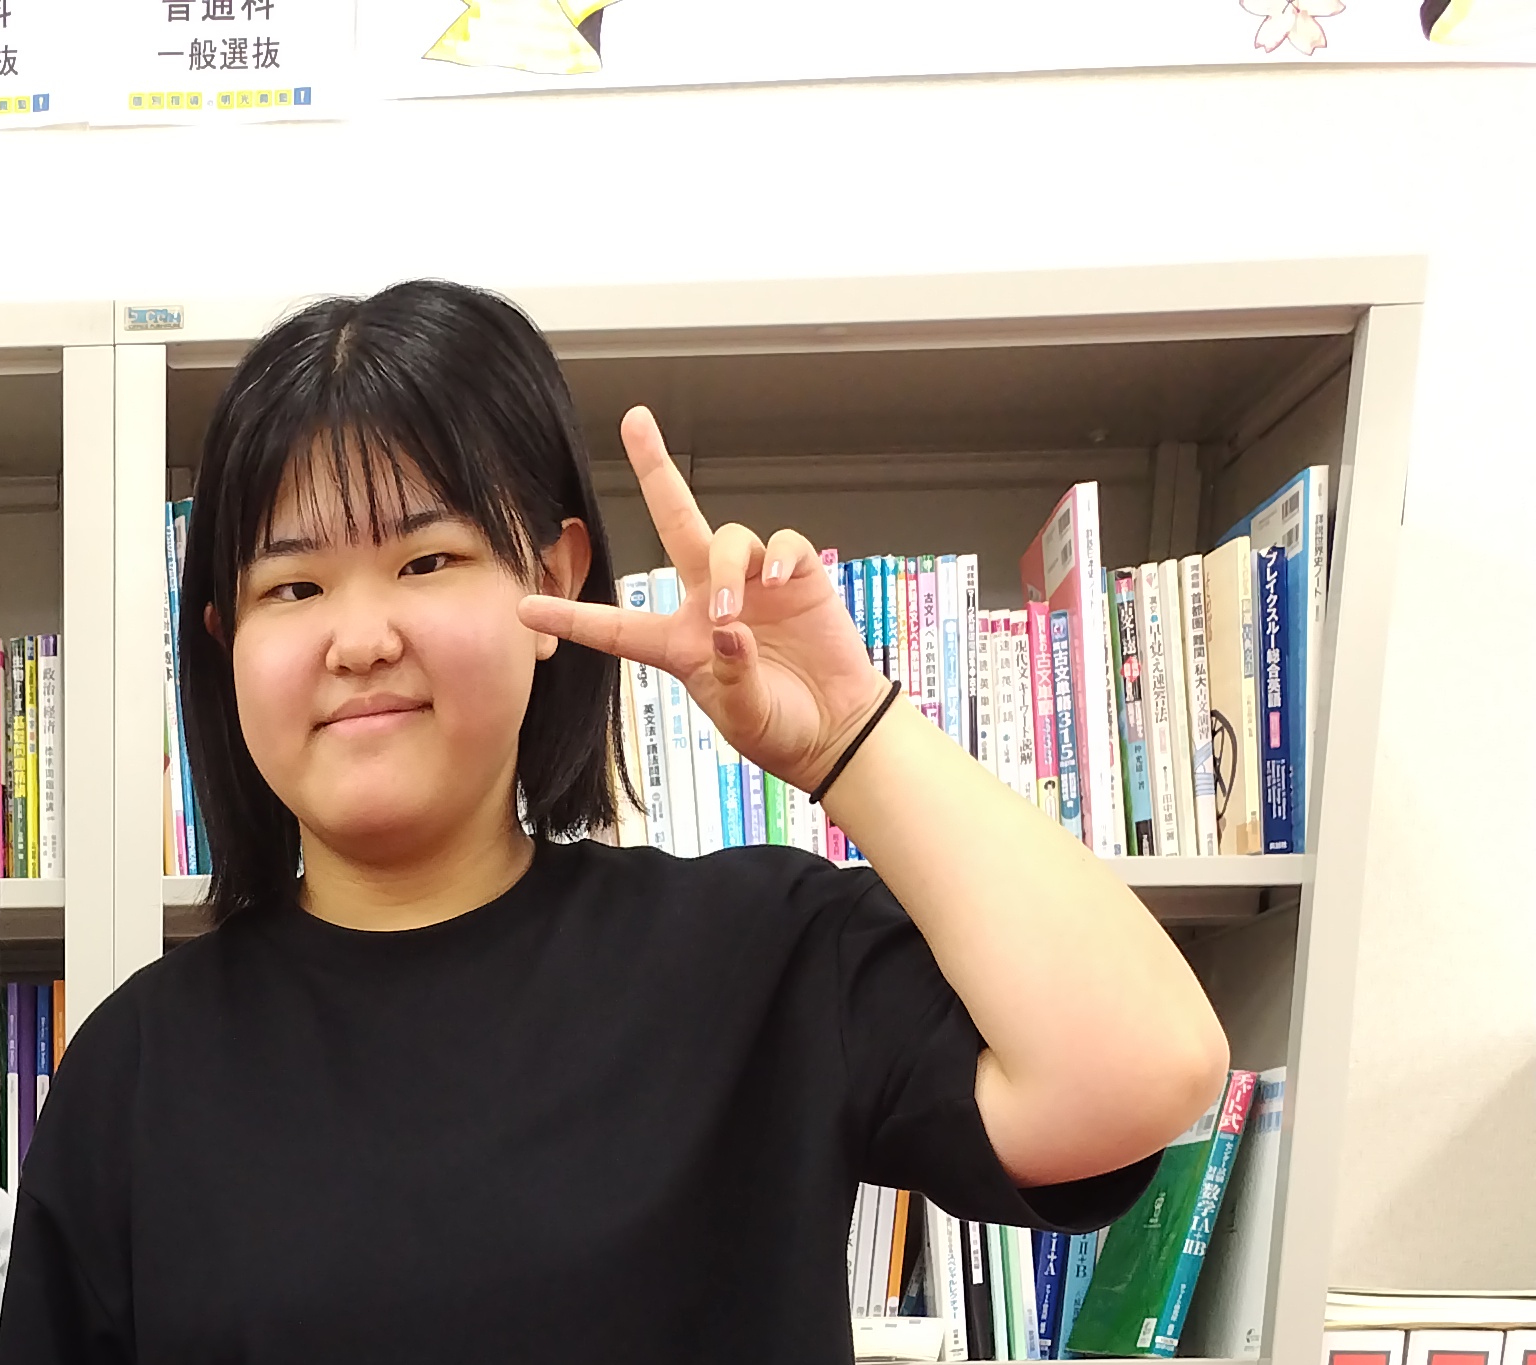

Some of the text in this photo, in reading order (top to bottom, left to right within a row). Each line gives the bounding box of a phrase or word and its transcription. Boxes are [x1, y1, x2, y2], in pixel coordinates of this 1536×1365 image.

[157, 37, 281, 71] 一般選抜
[923, 592, 936, 698] 古文レベル別問題集
[1264, 551, 1282, 708] ブレイクスルー総合英語
[42, 667, 56, 735] 政治・経済
[1221, 1073, 1254, 1131] チャート式
